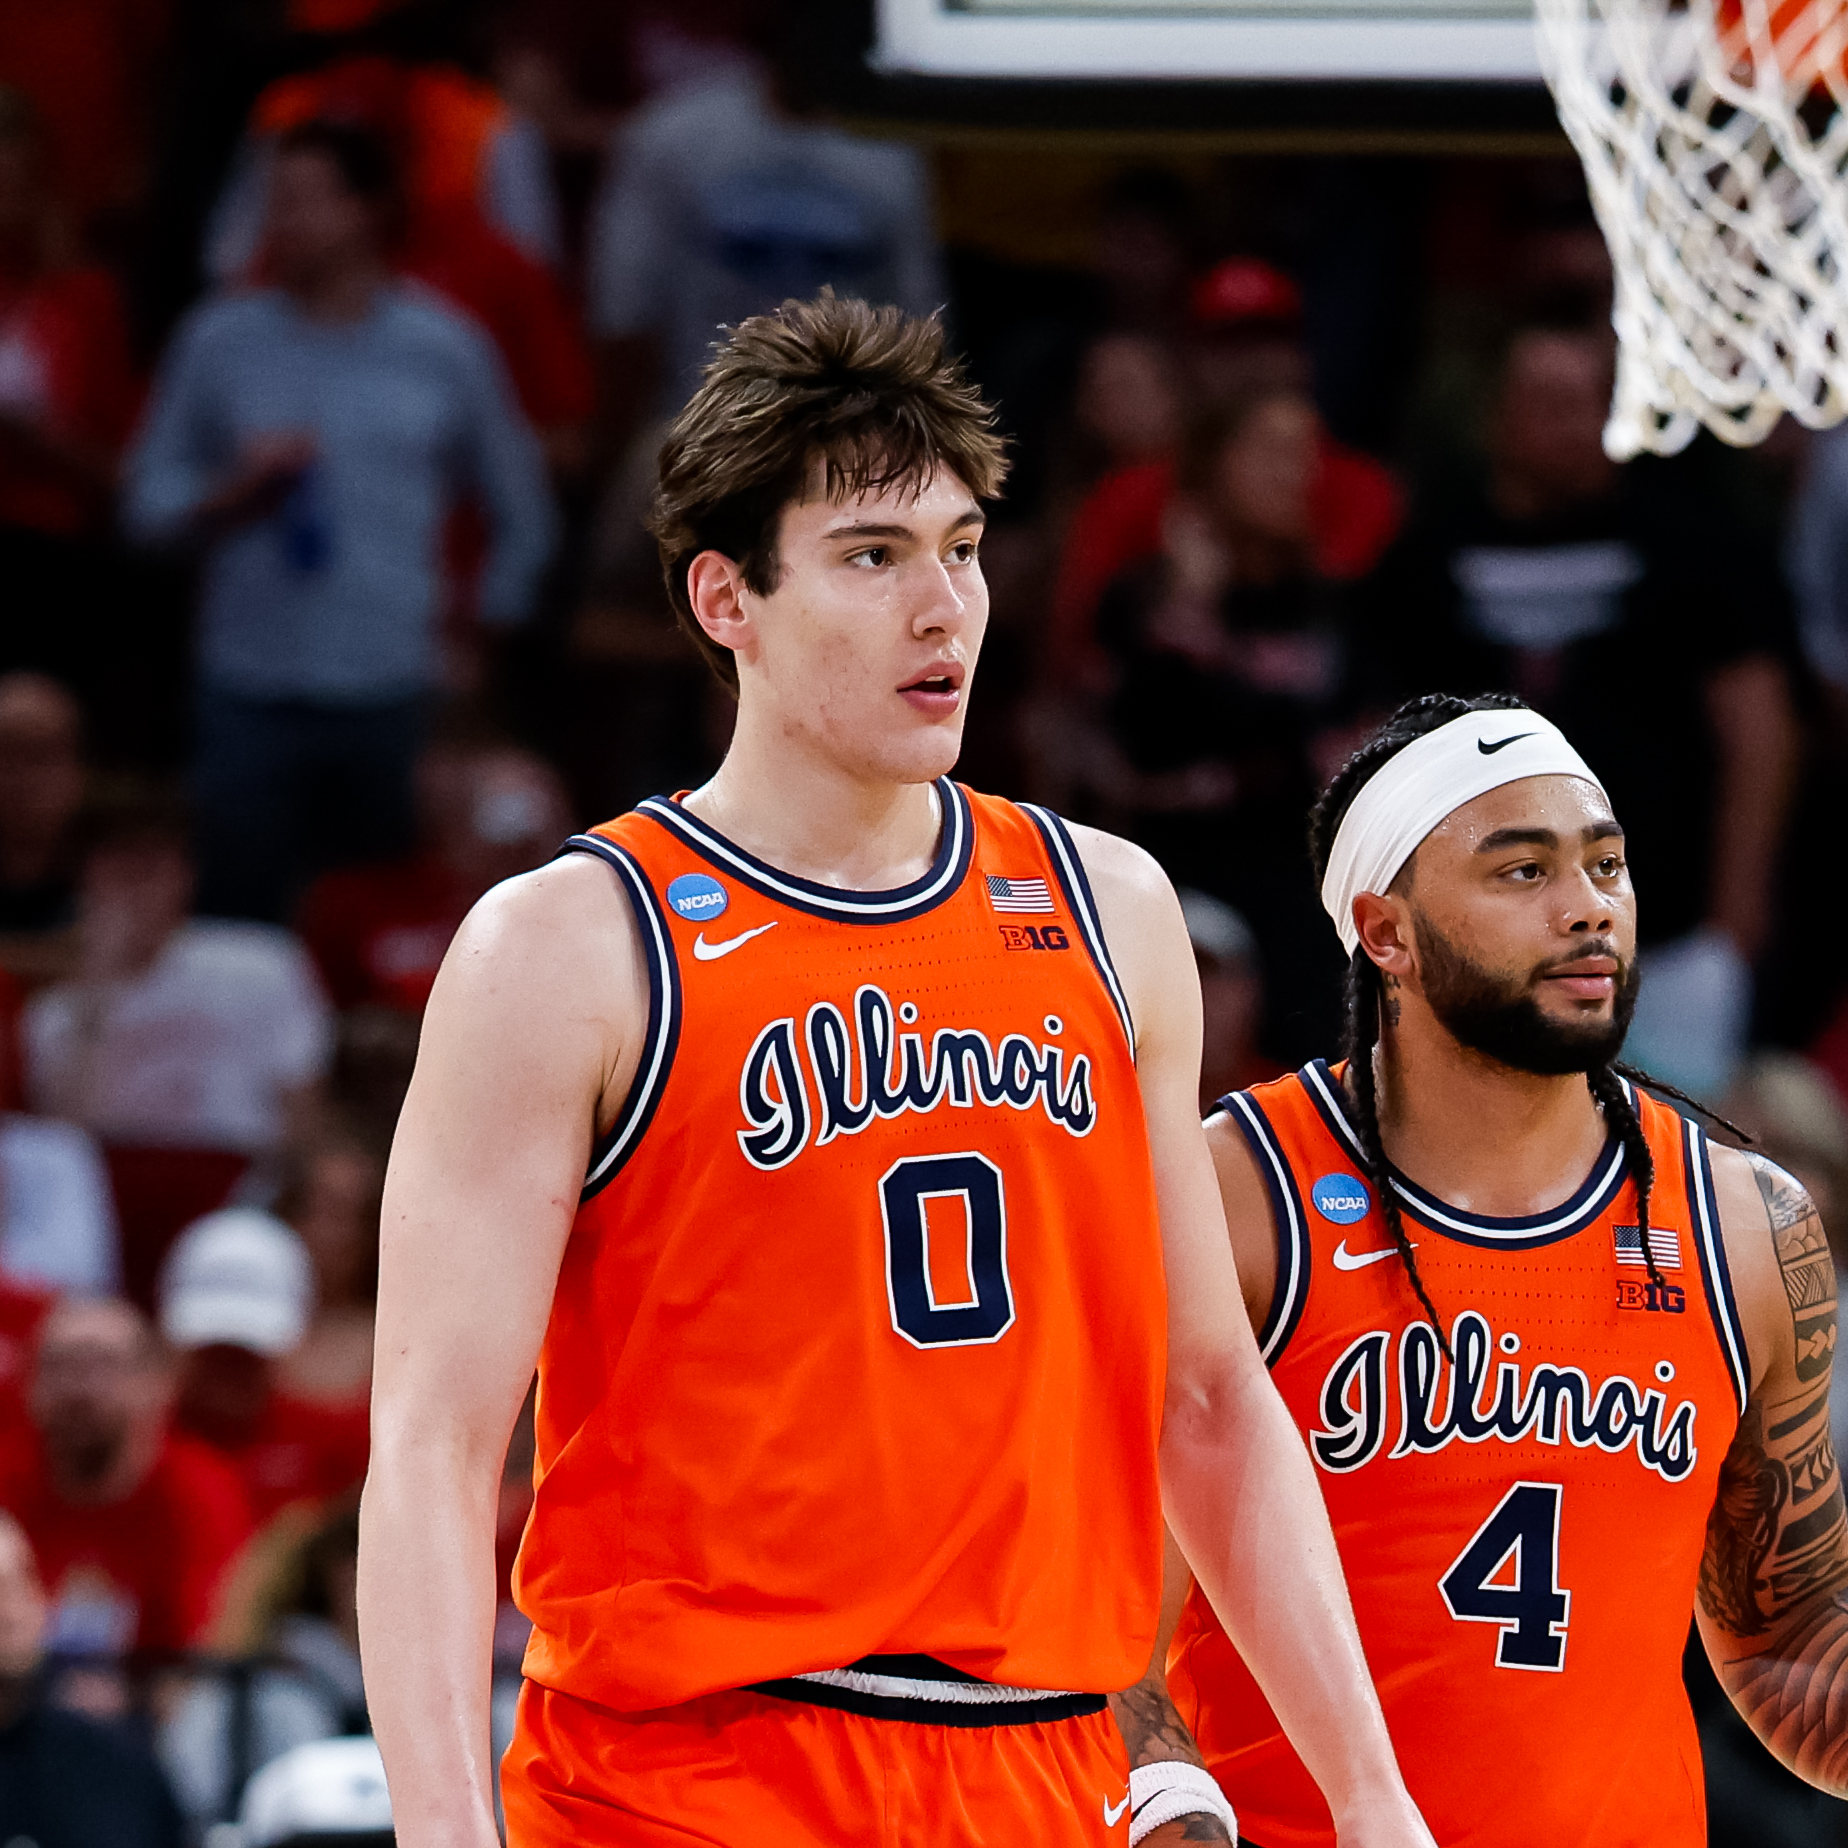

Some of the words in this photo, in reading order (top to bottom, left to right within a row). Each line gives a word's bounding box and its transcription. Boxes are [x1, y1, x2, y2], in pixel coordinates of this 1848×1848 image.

[678, 890, 725, 912] NCAA
[736, 984, 1096, 1171] Illinois
[878, 1151, 1016, 1349] 0
[1321, 1195, 1367, 1211] NCAA
[1309, 1311, 1696, 1482] Illinois
[1437, 1481, 1571, 1673] 4
